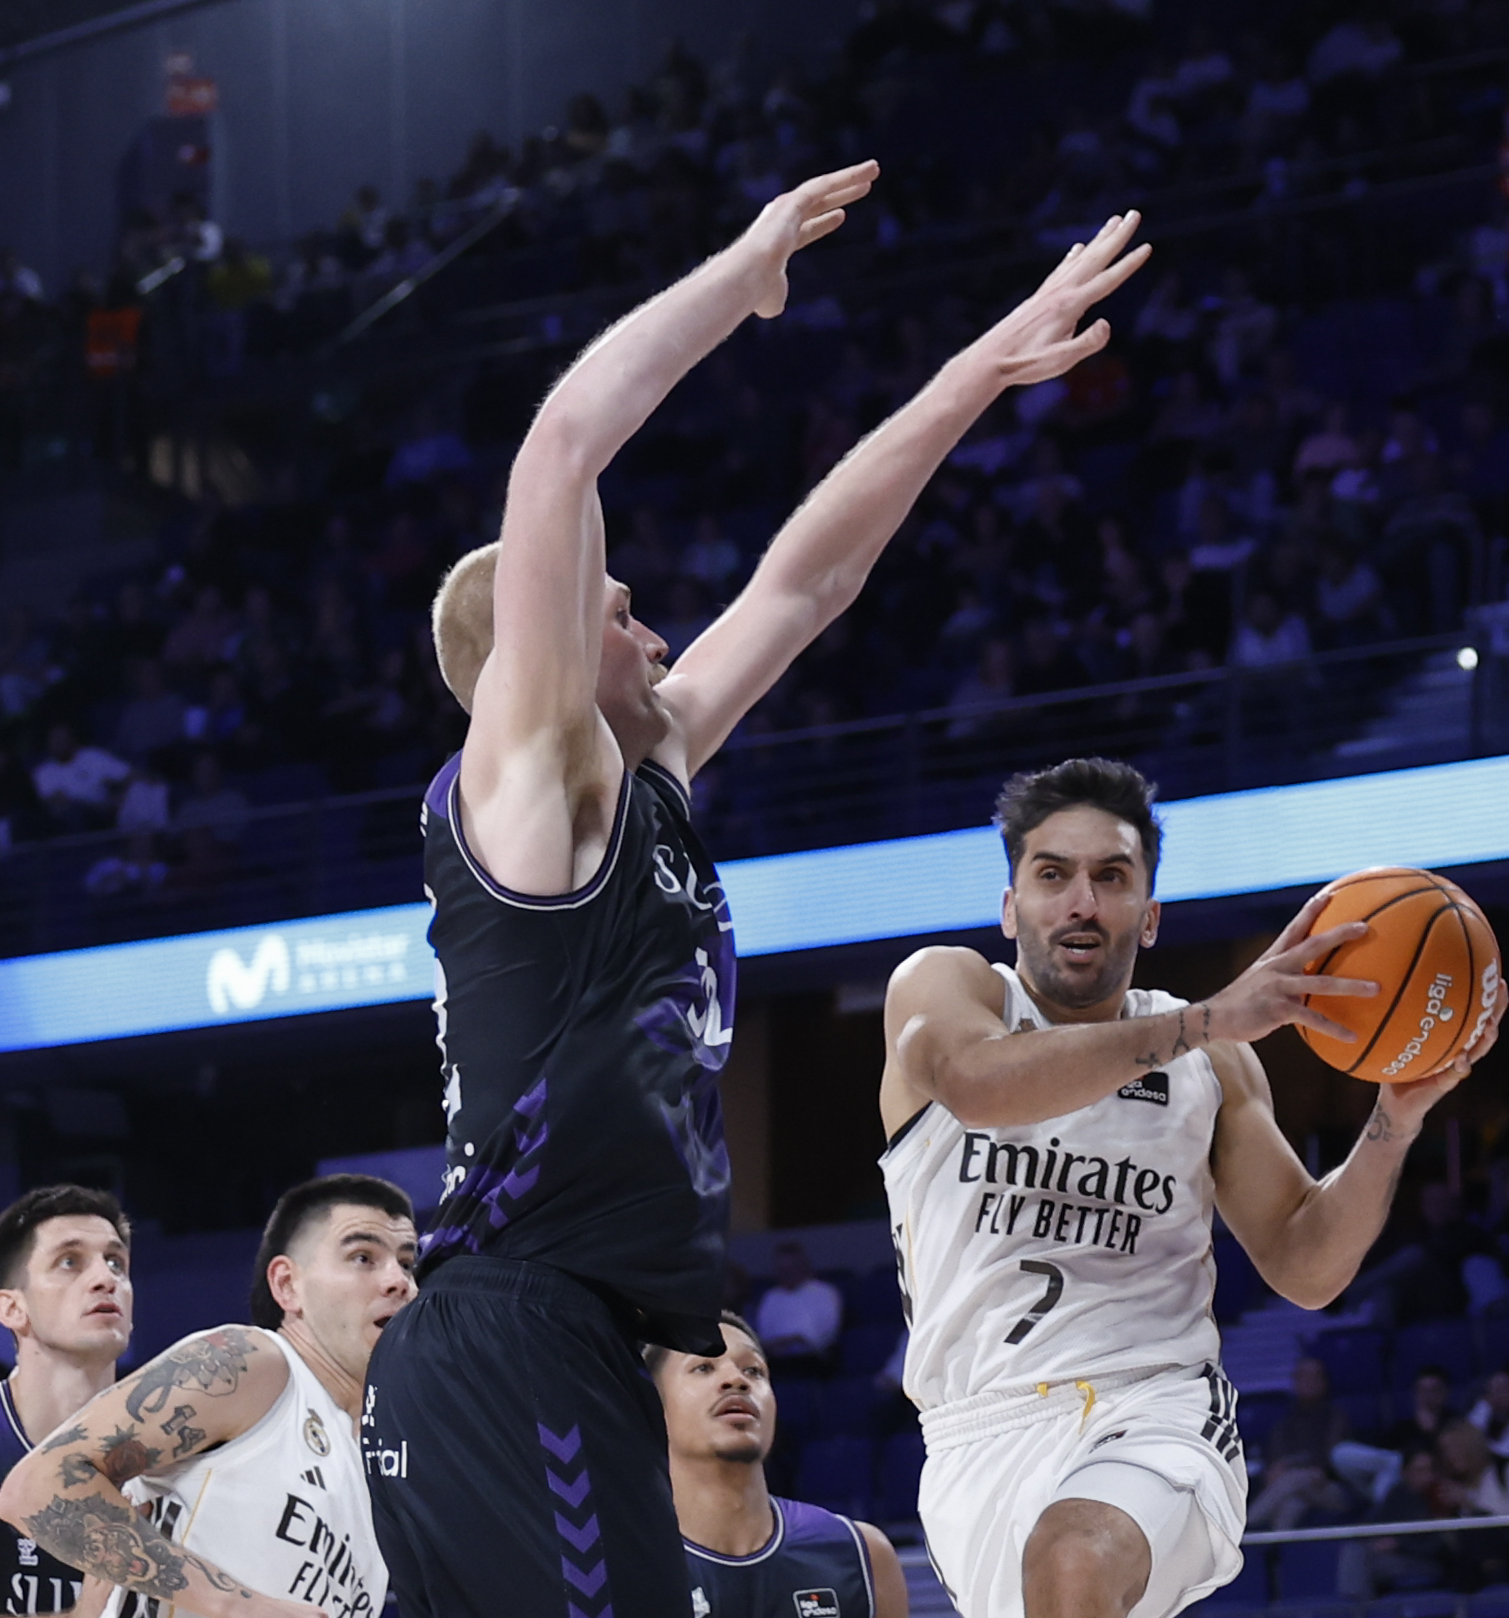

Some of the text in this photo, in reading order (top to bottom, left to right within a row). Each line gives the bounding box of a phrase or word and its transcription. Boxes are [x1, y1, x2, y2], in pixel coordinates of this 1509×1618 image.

[1380, 972, 1453, 1077] liga endesa
[1121, 1087, 1167, 1102] endesa
[958, 1131, 1176, 1214] Emirates
[975, 1192, 1143, 1255] FLY BETTER
[1003, 1259, 1064, 1345] 7
